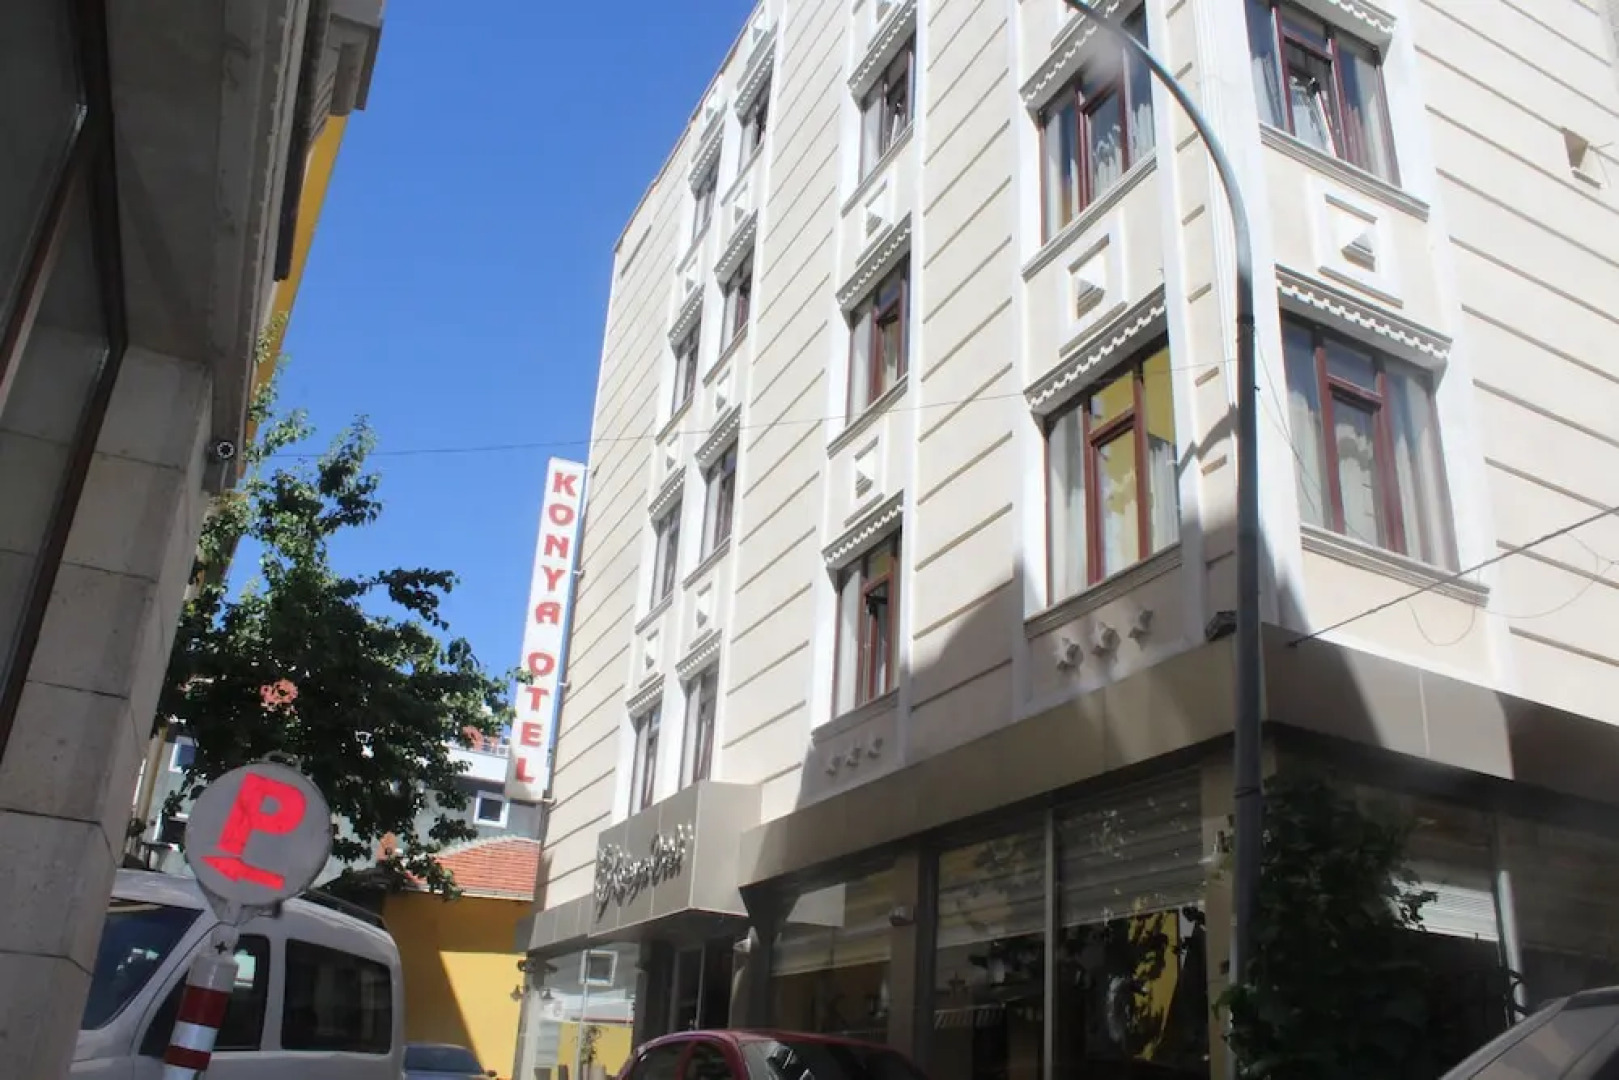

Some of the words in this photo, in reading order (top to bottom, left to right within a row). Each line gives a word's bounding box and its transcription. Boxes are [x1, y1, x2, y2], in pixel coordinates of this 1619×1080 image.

[535, 470, 578, 625] KONYA
[515, 652, 555, 783] OTEL
[217, 772, 307, 855] P
